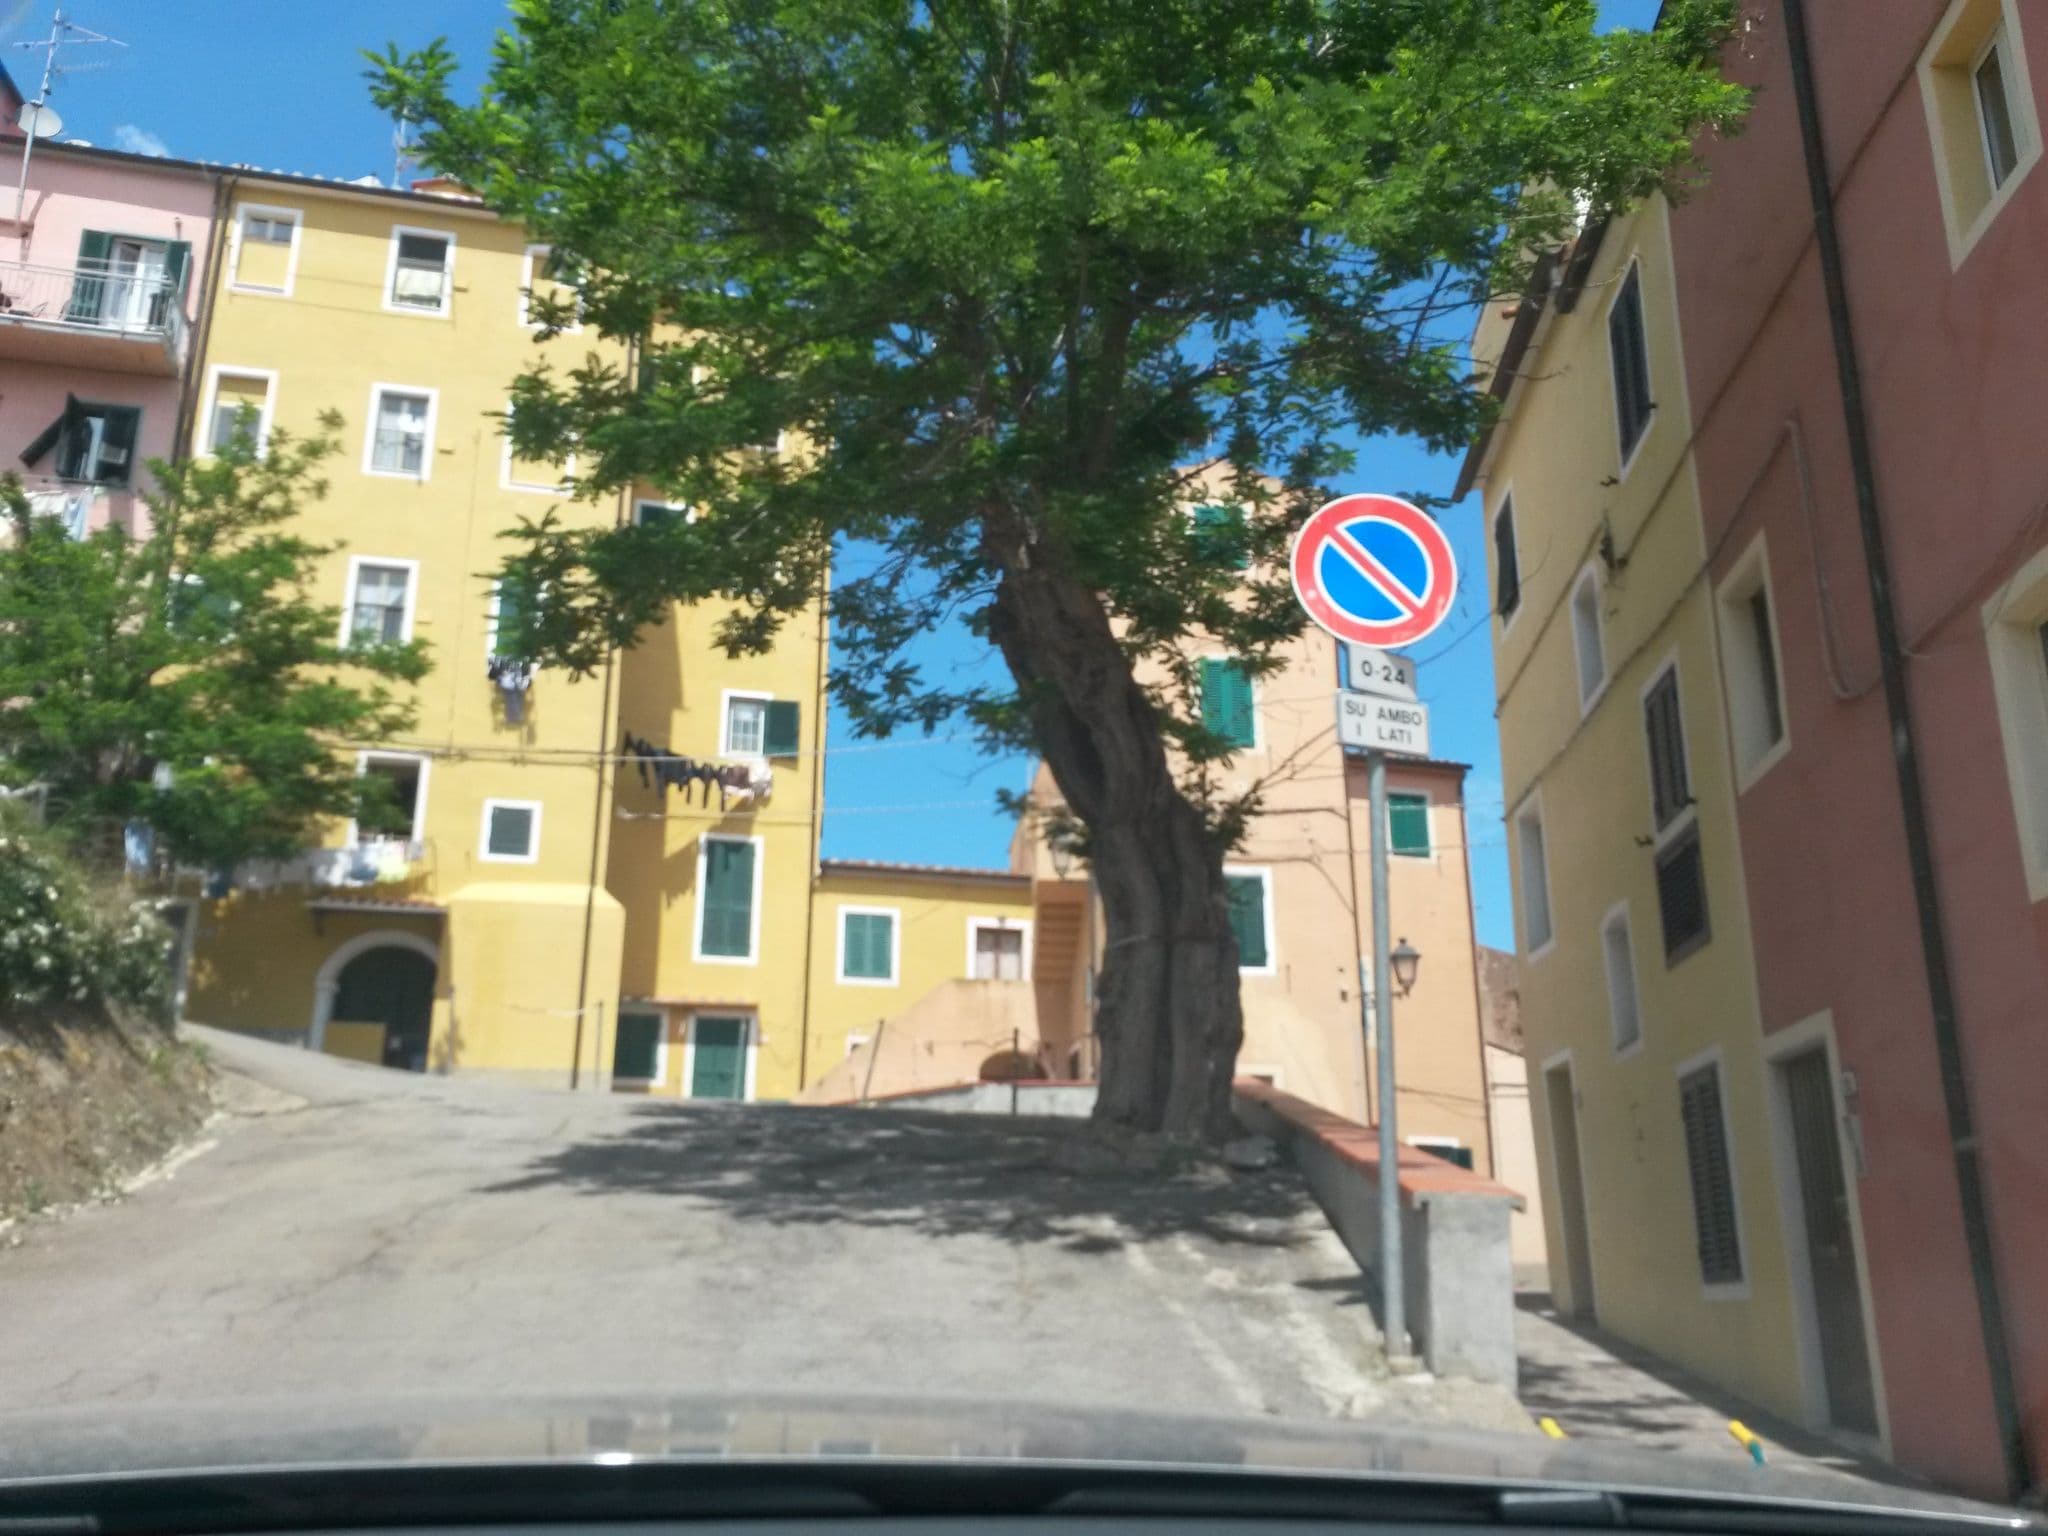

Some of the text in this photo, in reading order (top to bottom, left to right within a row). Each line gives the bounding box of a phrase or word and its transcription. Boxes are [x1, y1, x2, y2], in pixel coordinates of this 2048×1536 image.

[1361, 660, 1406, 685] 0-24
[1345, 699, 1422, 726] SU AMBO
[1356, 722, 1412, 744] I LATI
